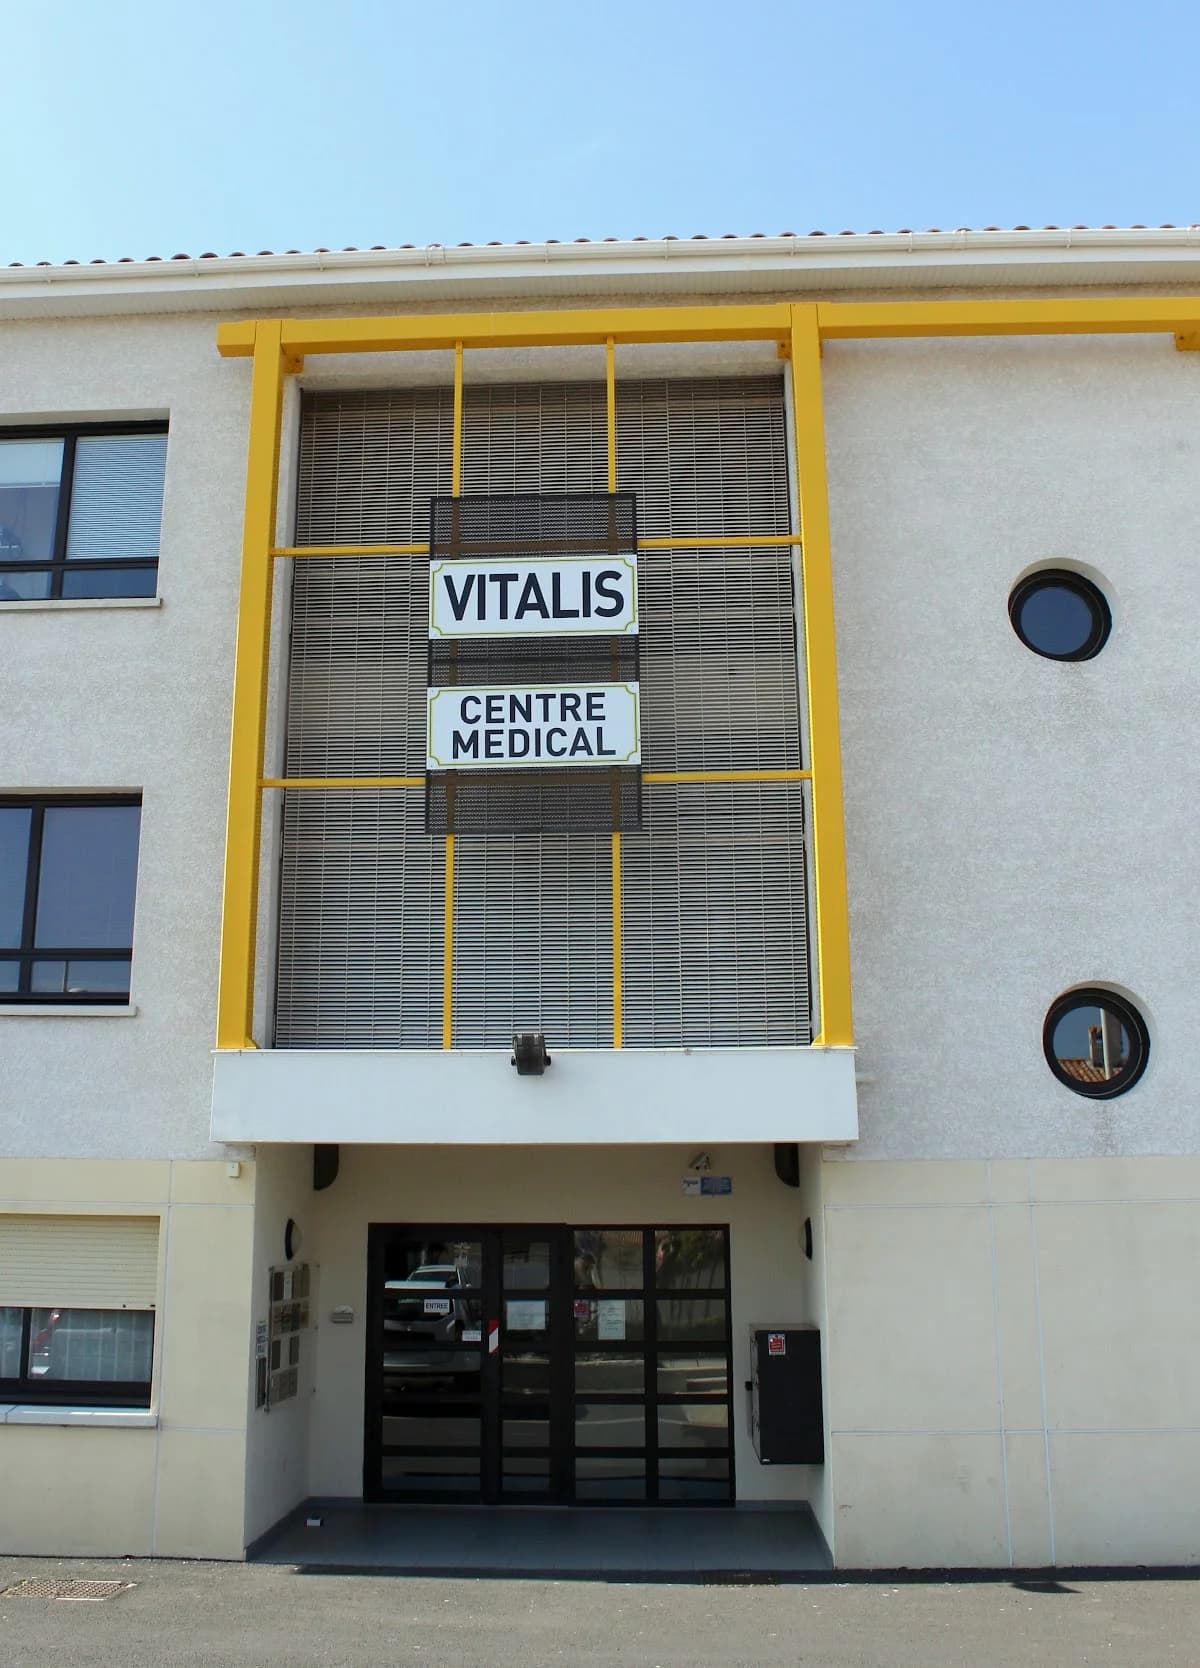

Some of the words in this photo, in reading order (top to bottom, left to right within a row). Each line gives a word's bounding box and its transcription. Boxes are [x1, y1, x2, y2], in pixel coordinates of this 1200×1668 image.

[444, 571, 625, 620] VITALIS
[460, 692, 606, 724] CENTRE
[452, 727, 617, 760] MEDICAL
